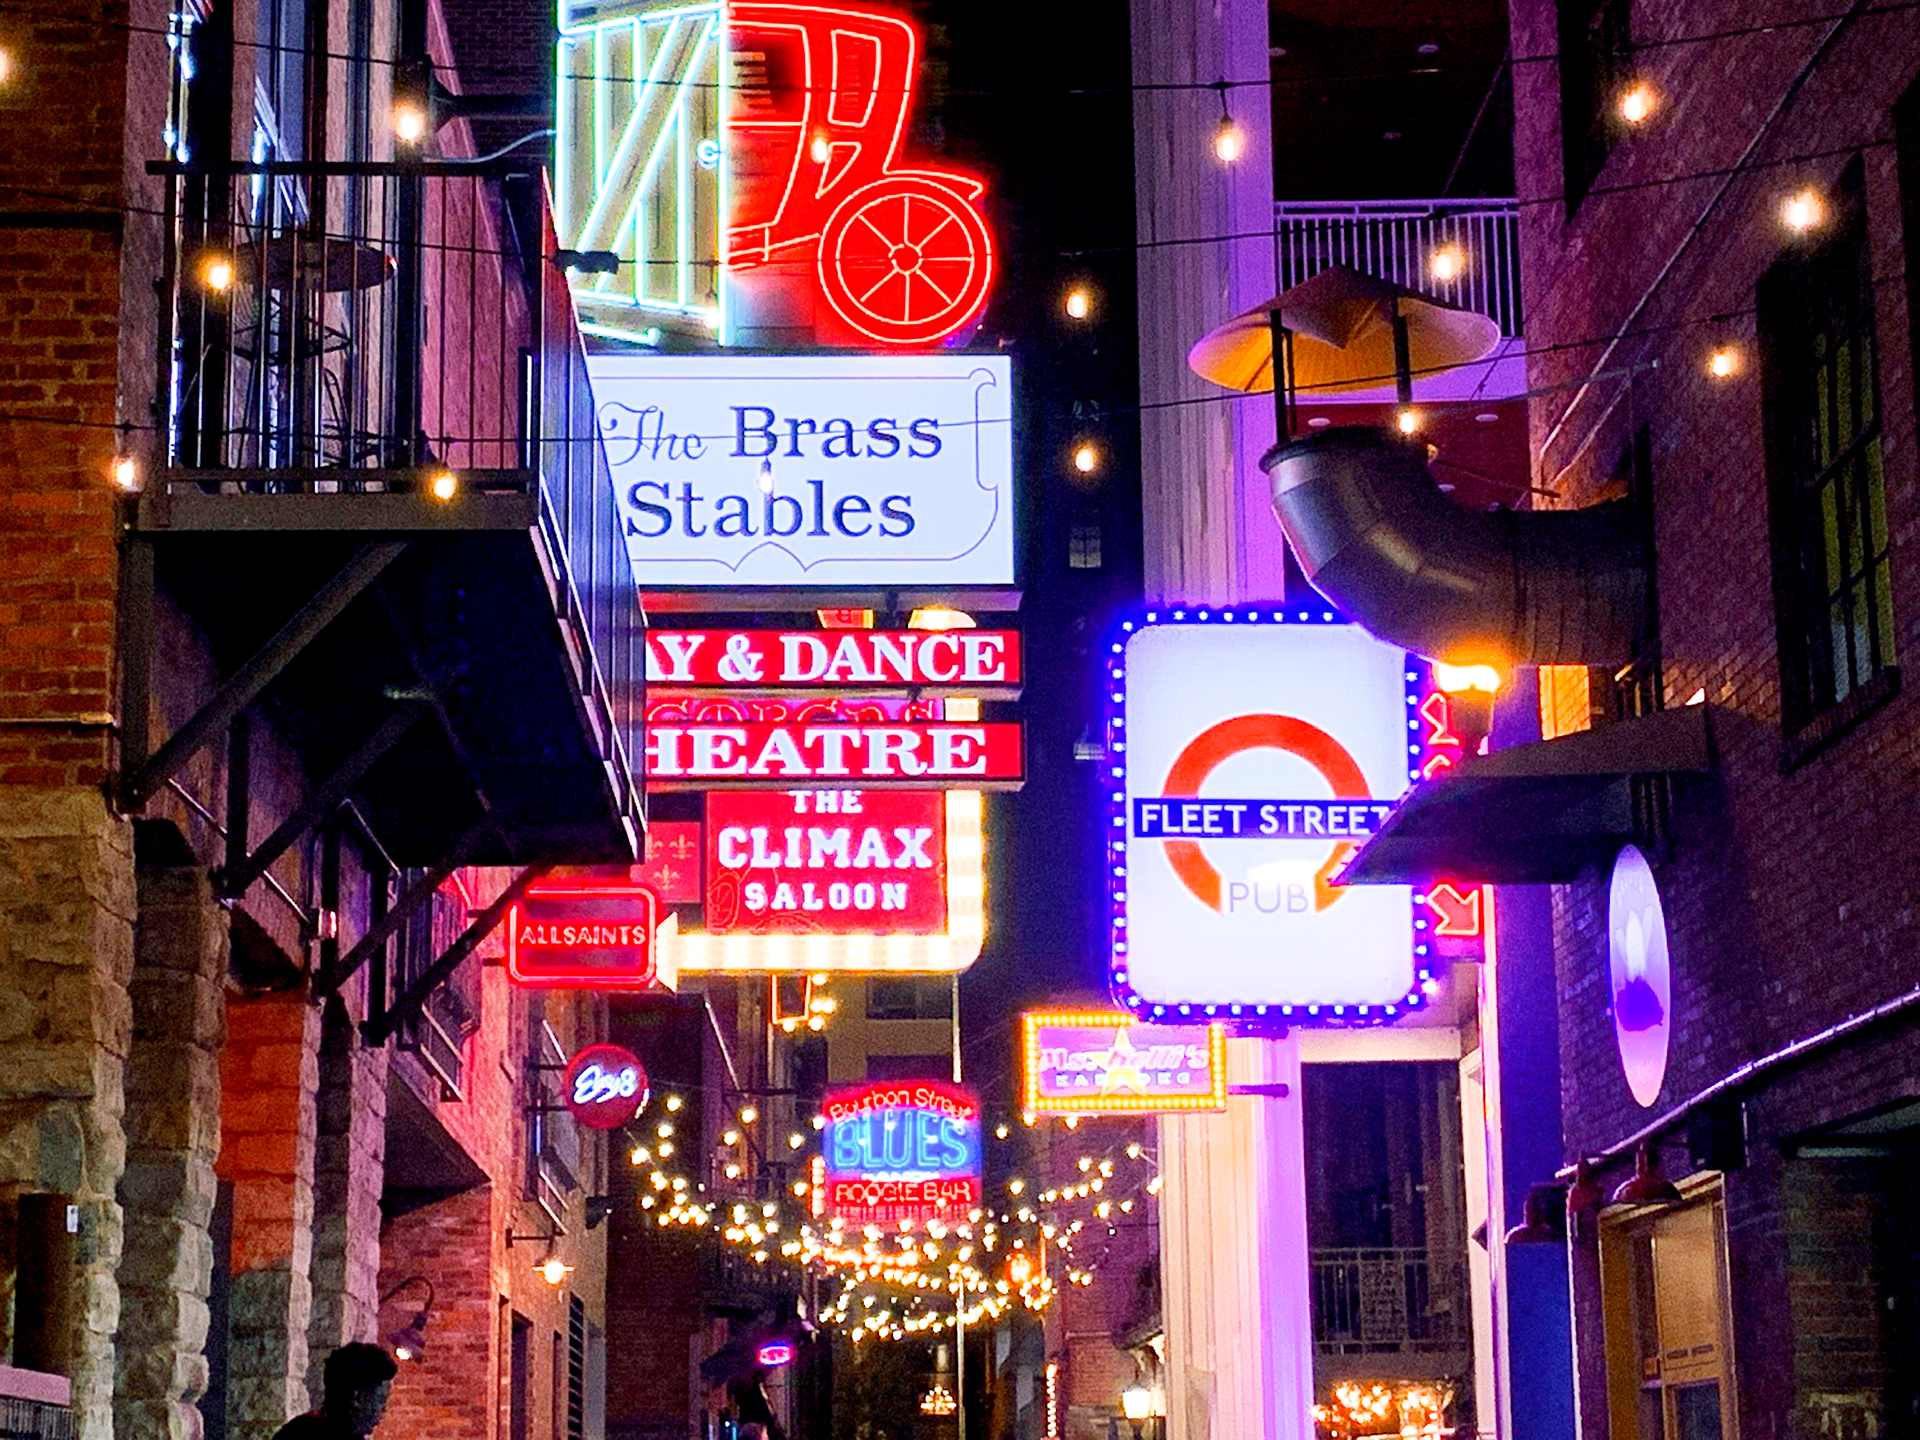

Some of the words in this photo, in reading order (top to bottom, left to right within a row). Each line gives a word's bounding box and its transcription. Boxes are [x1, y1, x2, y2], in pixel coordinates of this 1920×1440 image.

[598, 401, 708, 466] The
[728, 405, 943, 459] Brass
[626, 479, 917, 539] Stables
[717, 634, 764, 682] &
[779, 635, 1005, 682] DANCE
[786, 790, 863, 814] THE
[1140, 804, 1248, 835] FLEET
[1258, 805, 1390, 835] STREET
[717, 827, 933, 869] CLIMAX
[744, 882, 908, 911] SALOON
[1229, 882, 1310, 914] PUB
[519, 924, 647, 946] ALLSAINTS
[829, 1090, 910, 1123] Bourbon
[833, 1108, 969, 1168] BLUES
